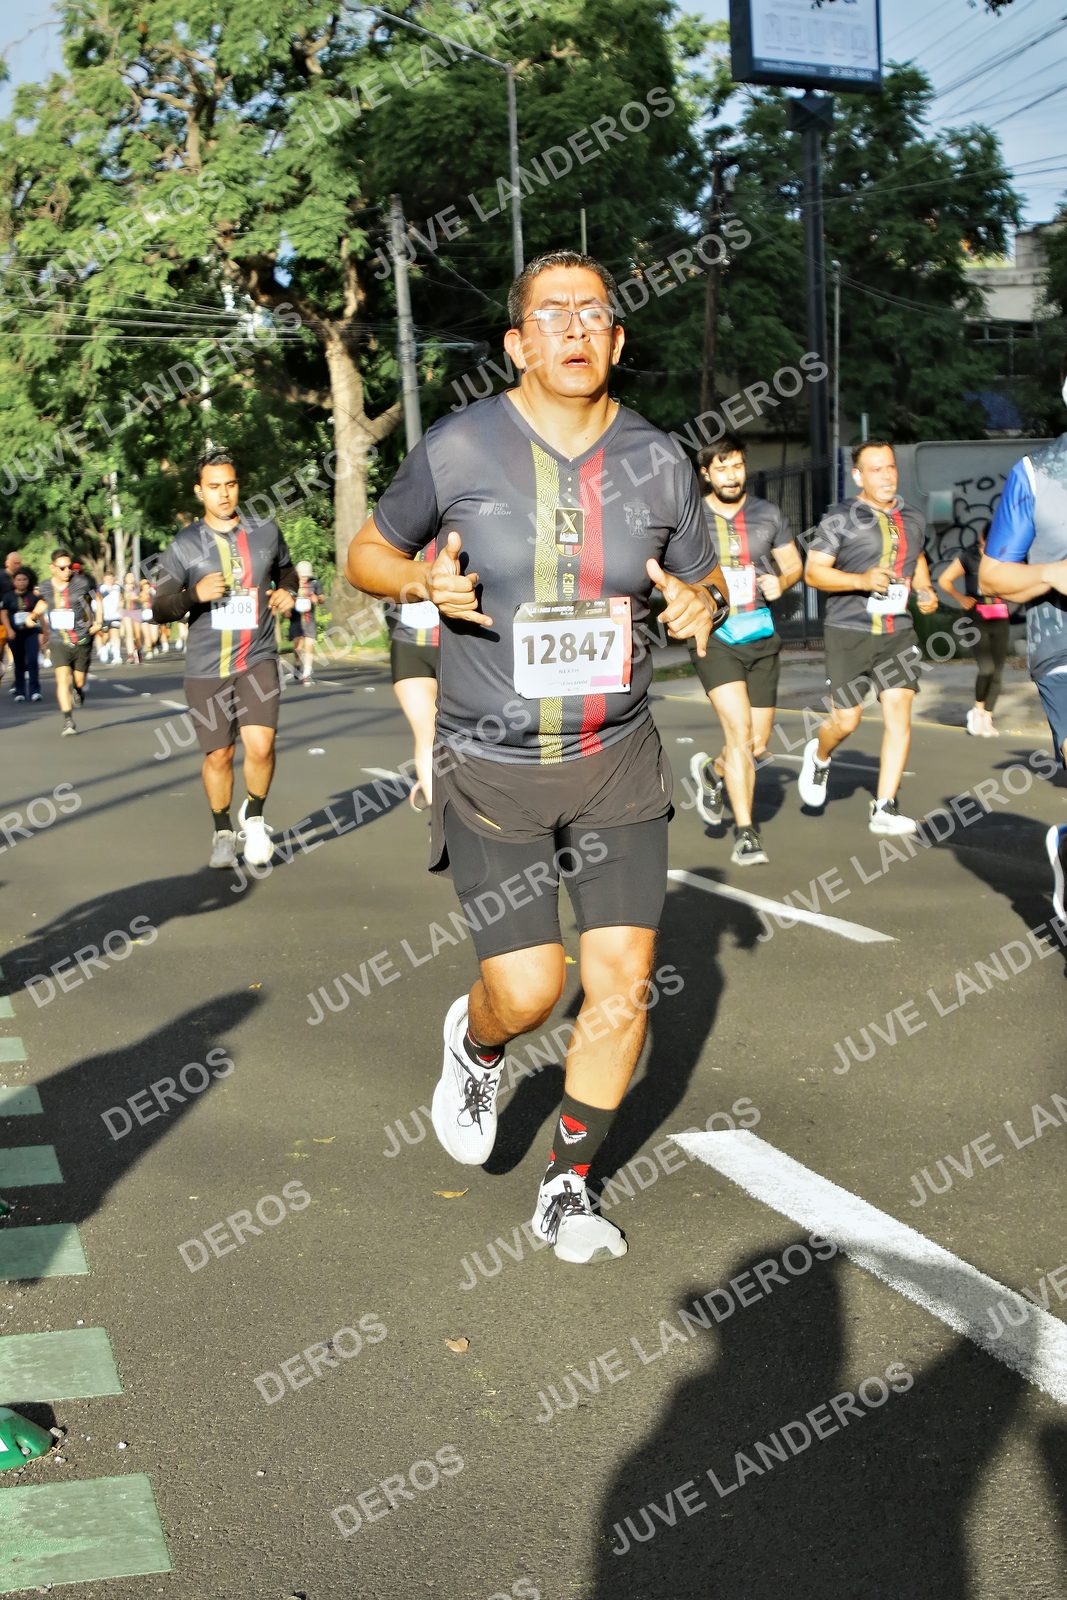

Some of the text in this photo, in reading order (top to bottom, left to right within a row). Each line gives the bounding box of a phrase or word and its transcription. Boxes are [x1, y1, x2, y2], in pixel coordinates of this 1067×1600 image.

[954, 473, 1007, 494] TO
[214, 601, 252, 614] 11308
[521, 631, 616, 665] 12847
